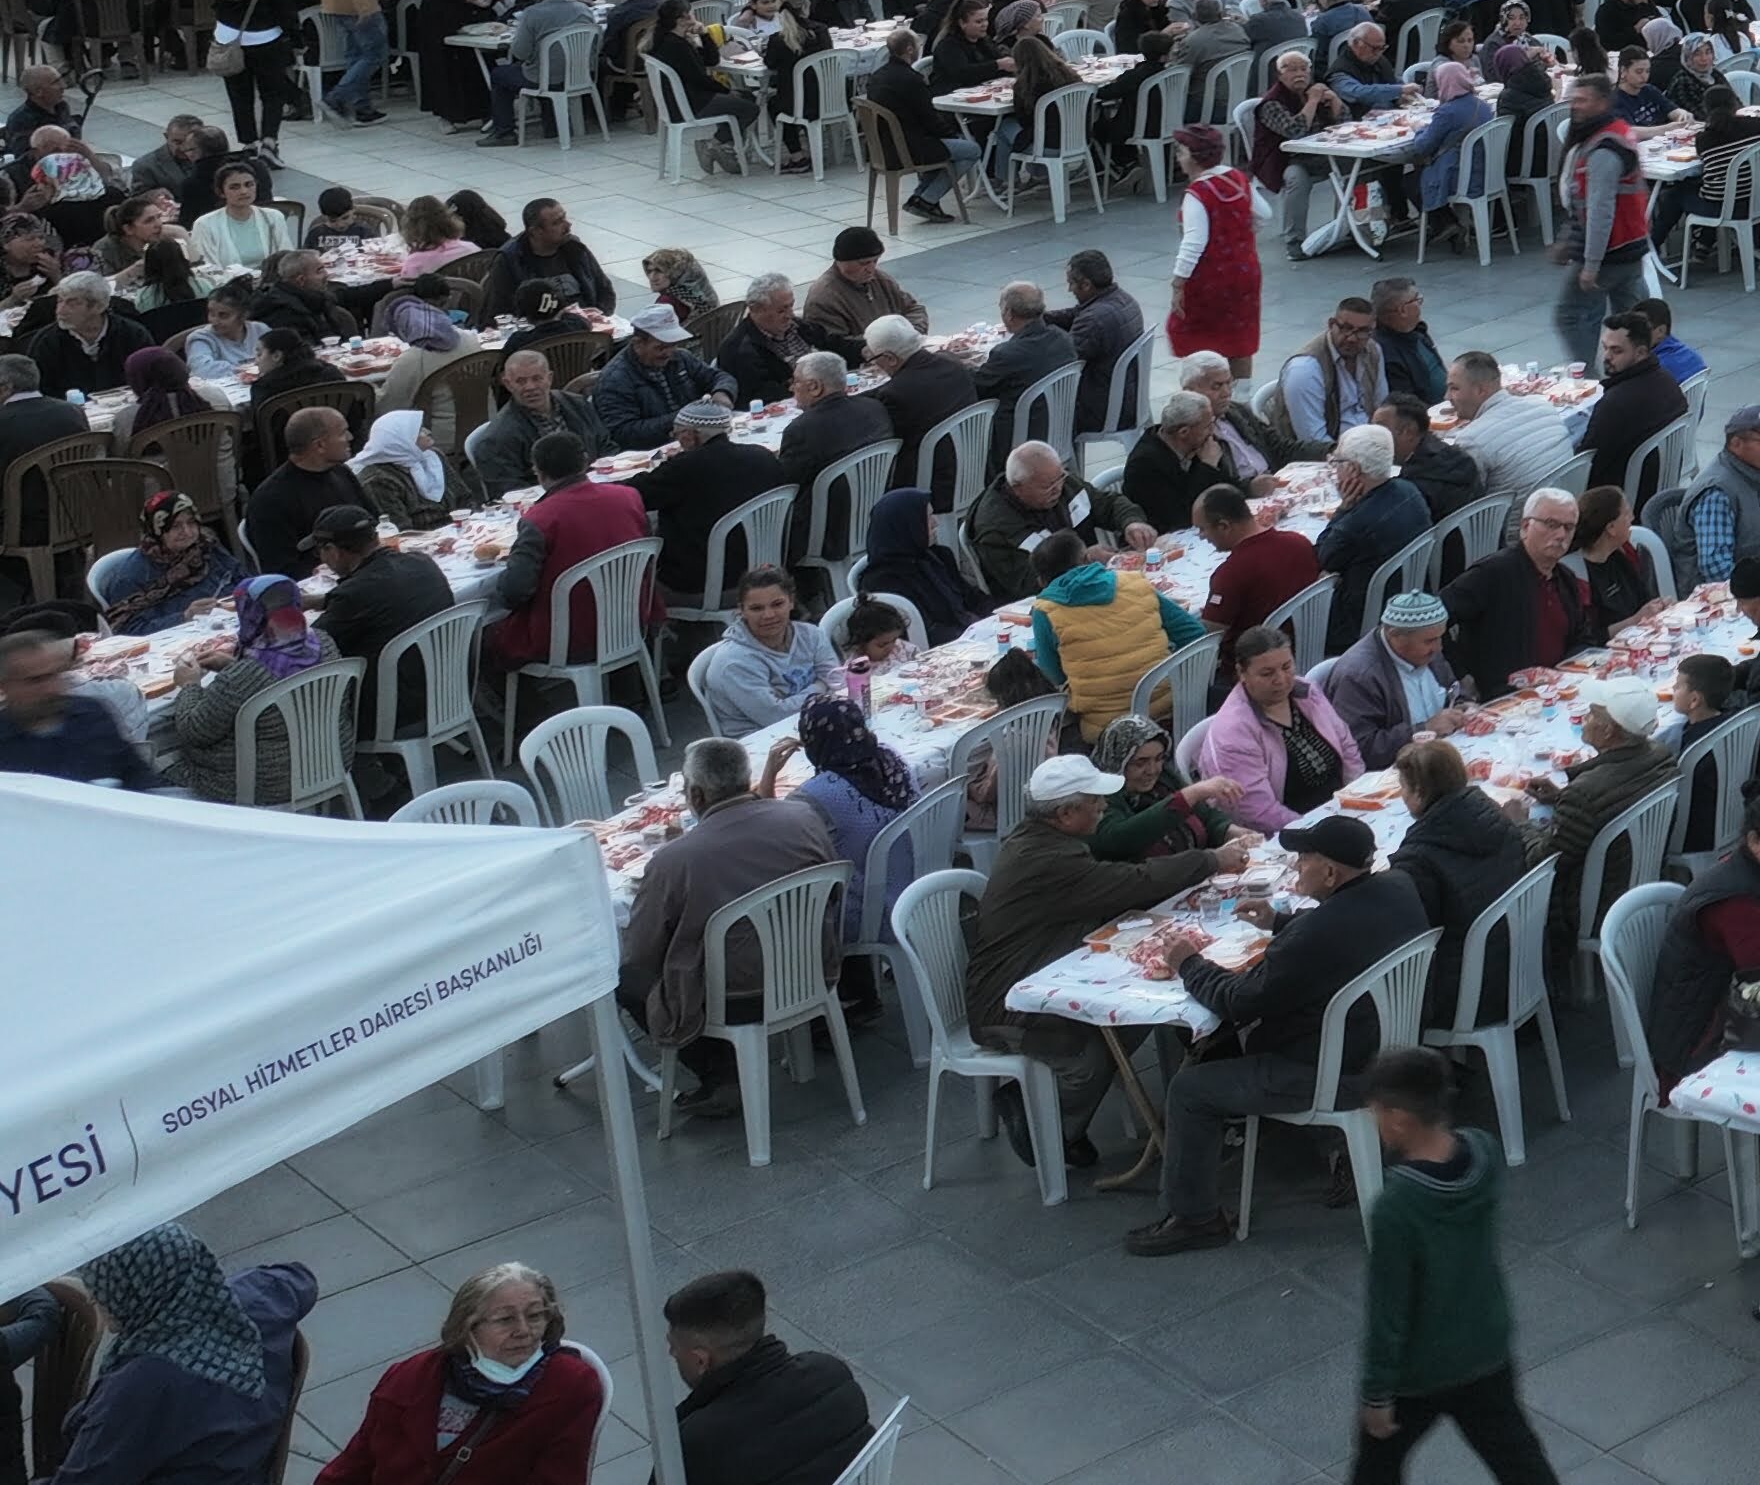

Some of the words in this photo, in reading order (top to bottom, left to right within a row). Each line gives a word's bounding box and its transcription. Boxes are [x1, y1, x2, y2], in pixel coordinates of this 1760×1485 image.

[162, 1081, 245, 1134] SOSYAL
[244, 1025, 358, 1095] HİZMETLER
[359, 982, 433, 1039] DAİRESİ
[435, 931, 544, 1001] BAŞKANLIĞI
